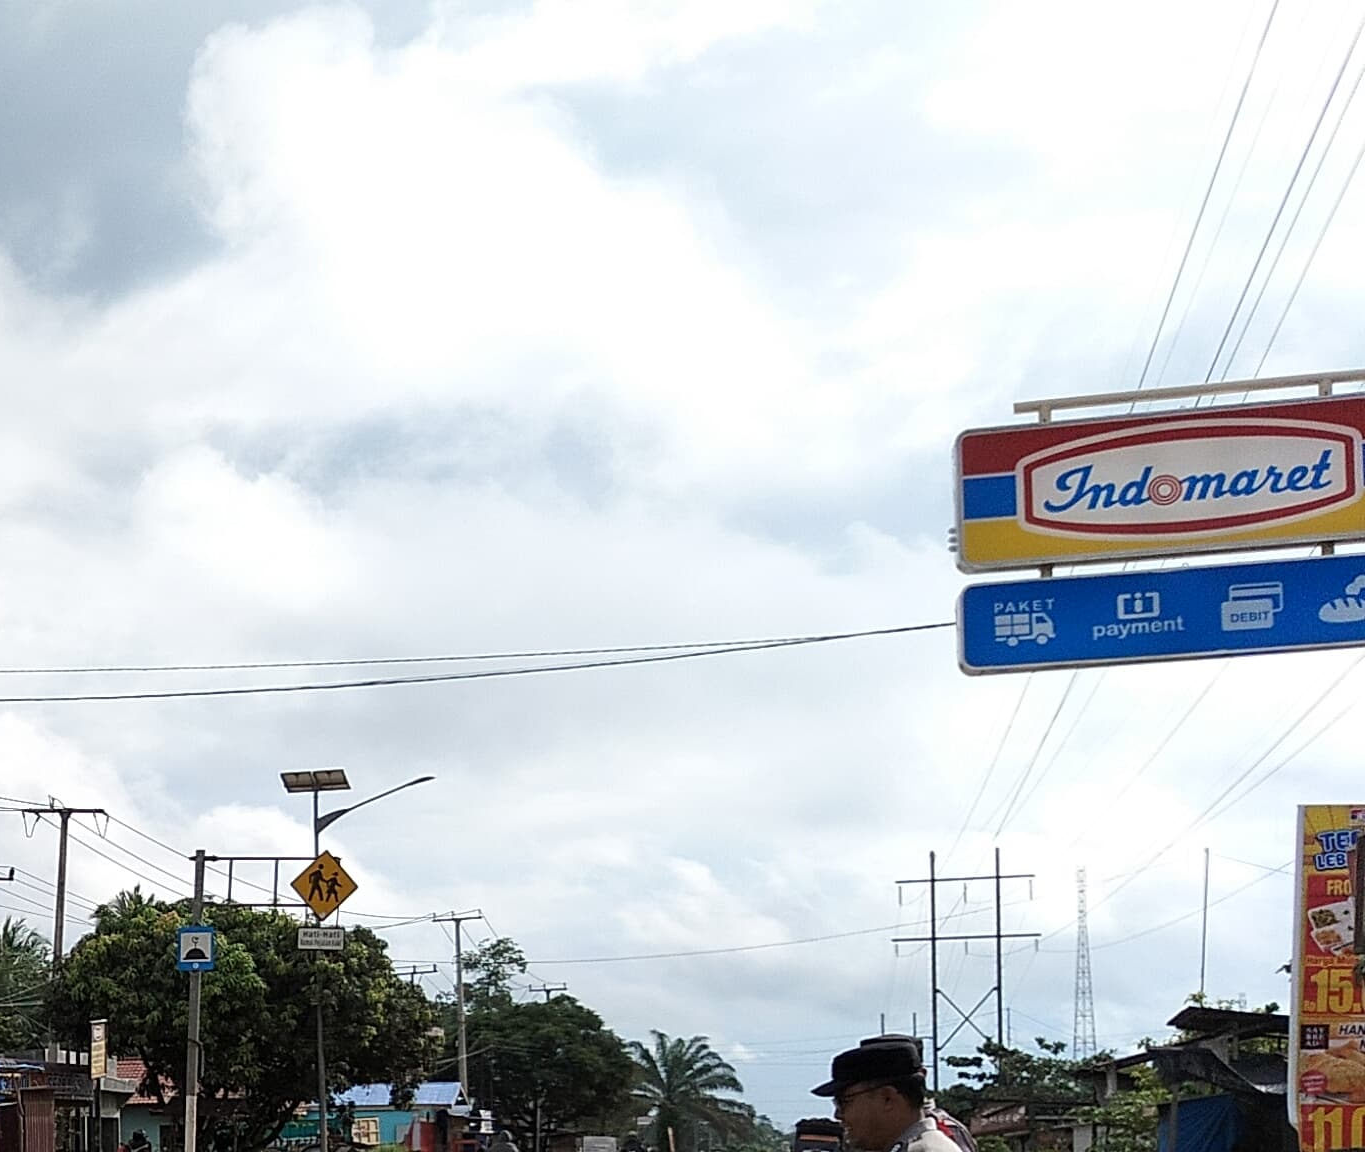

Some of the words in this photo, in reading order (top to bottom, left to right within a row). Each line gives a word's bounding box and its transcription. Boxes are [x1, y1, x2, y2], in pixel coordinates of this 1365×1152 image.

[1043, 448, 1333, 513] Indomaret
[994, 598, 1056, 614] PAKET
[1230, 610, 1270, 624] DEBIT
[1092, 615, 1186, 641] payment
[1316, 853, 1349, 870] LEB
[1326, 879, 1353, 896] FRO
[1310, 968, 1365, 1013] 15.
